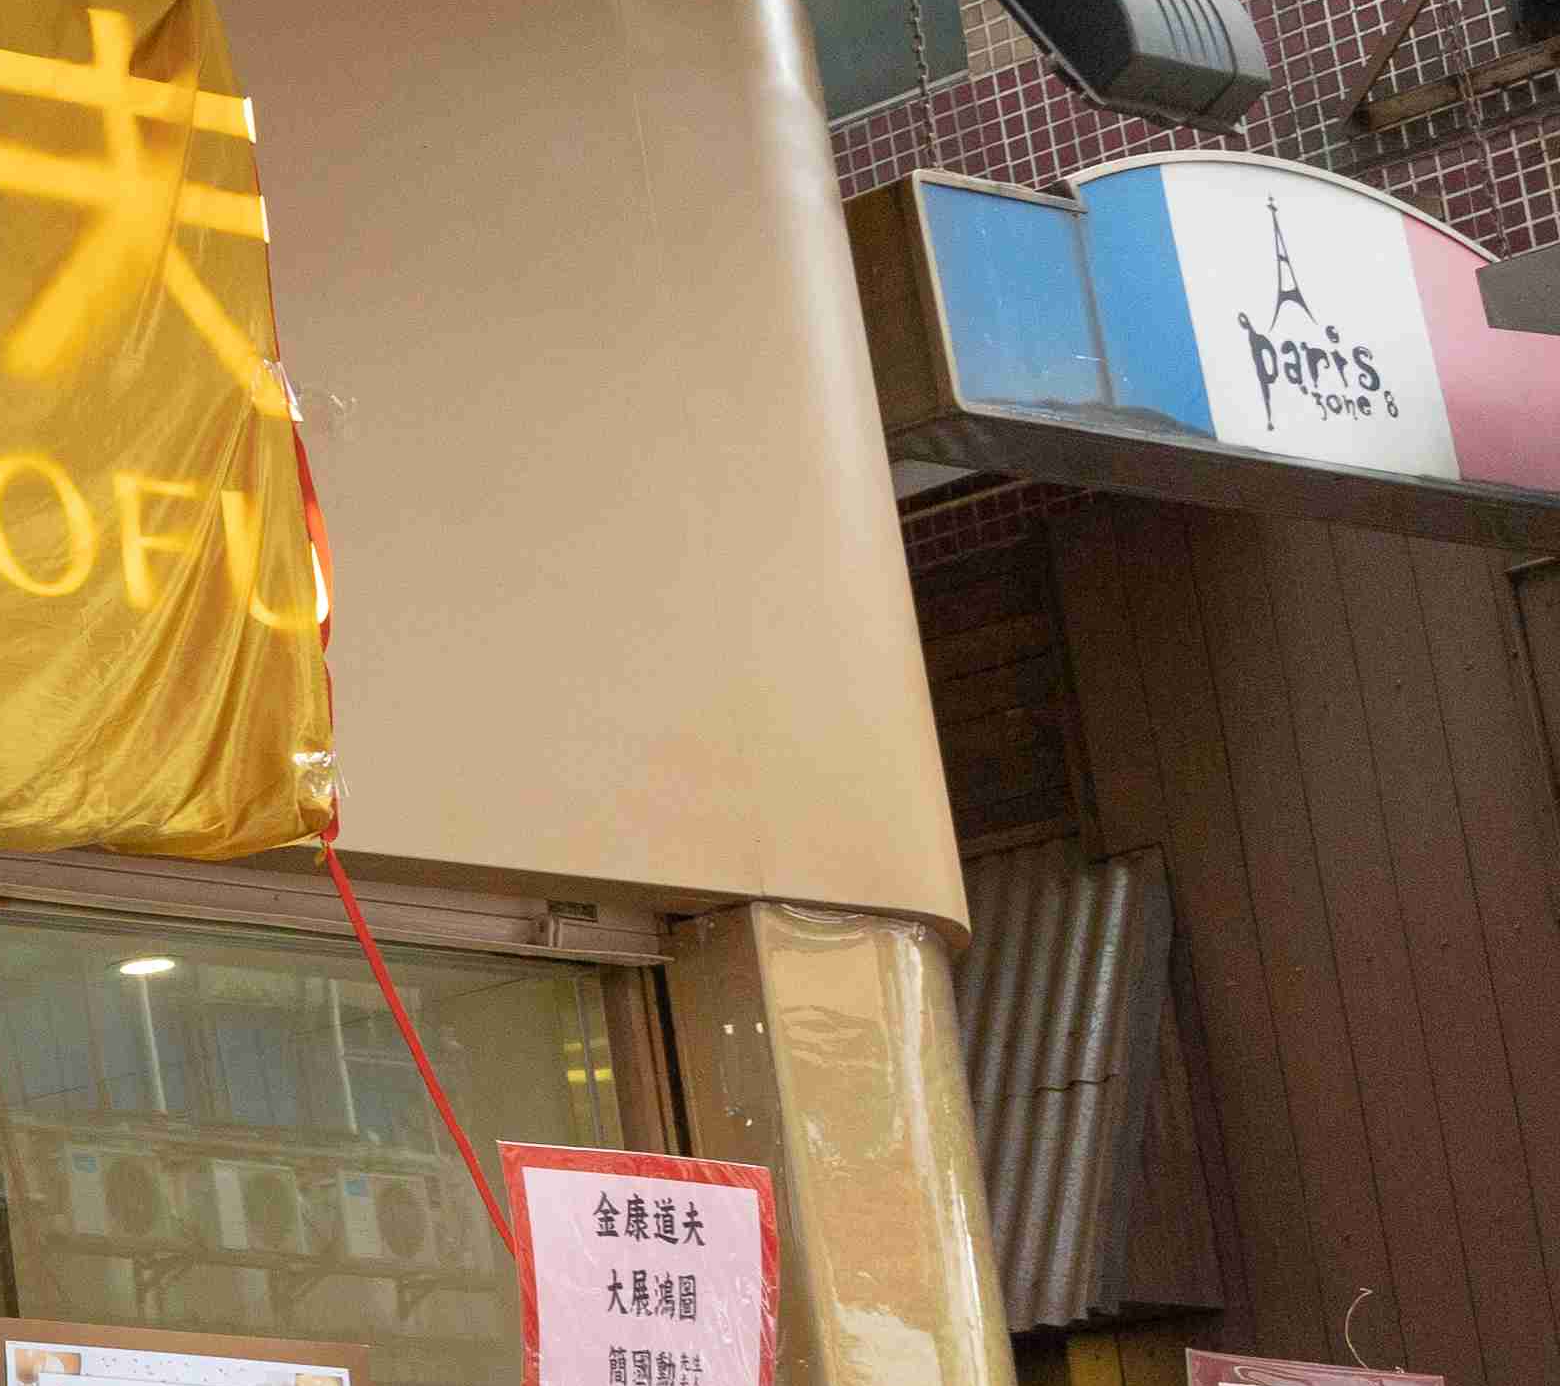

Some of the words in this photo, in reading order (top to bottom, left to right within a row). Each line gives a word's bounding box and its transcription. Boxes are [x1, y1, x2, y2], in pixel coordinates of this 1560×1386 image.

[594, 1191, 706, 1246] 金康道夫
[607, 1269, 697, 1321] 大展鴻圖
